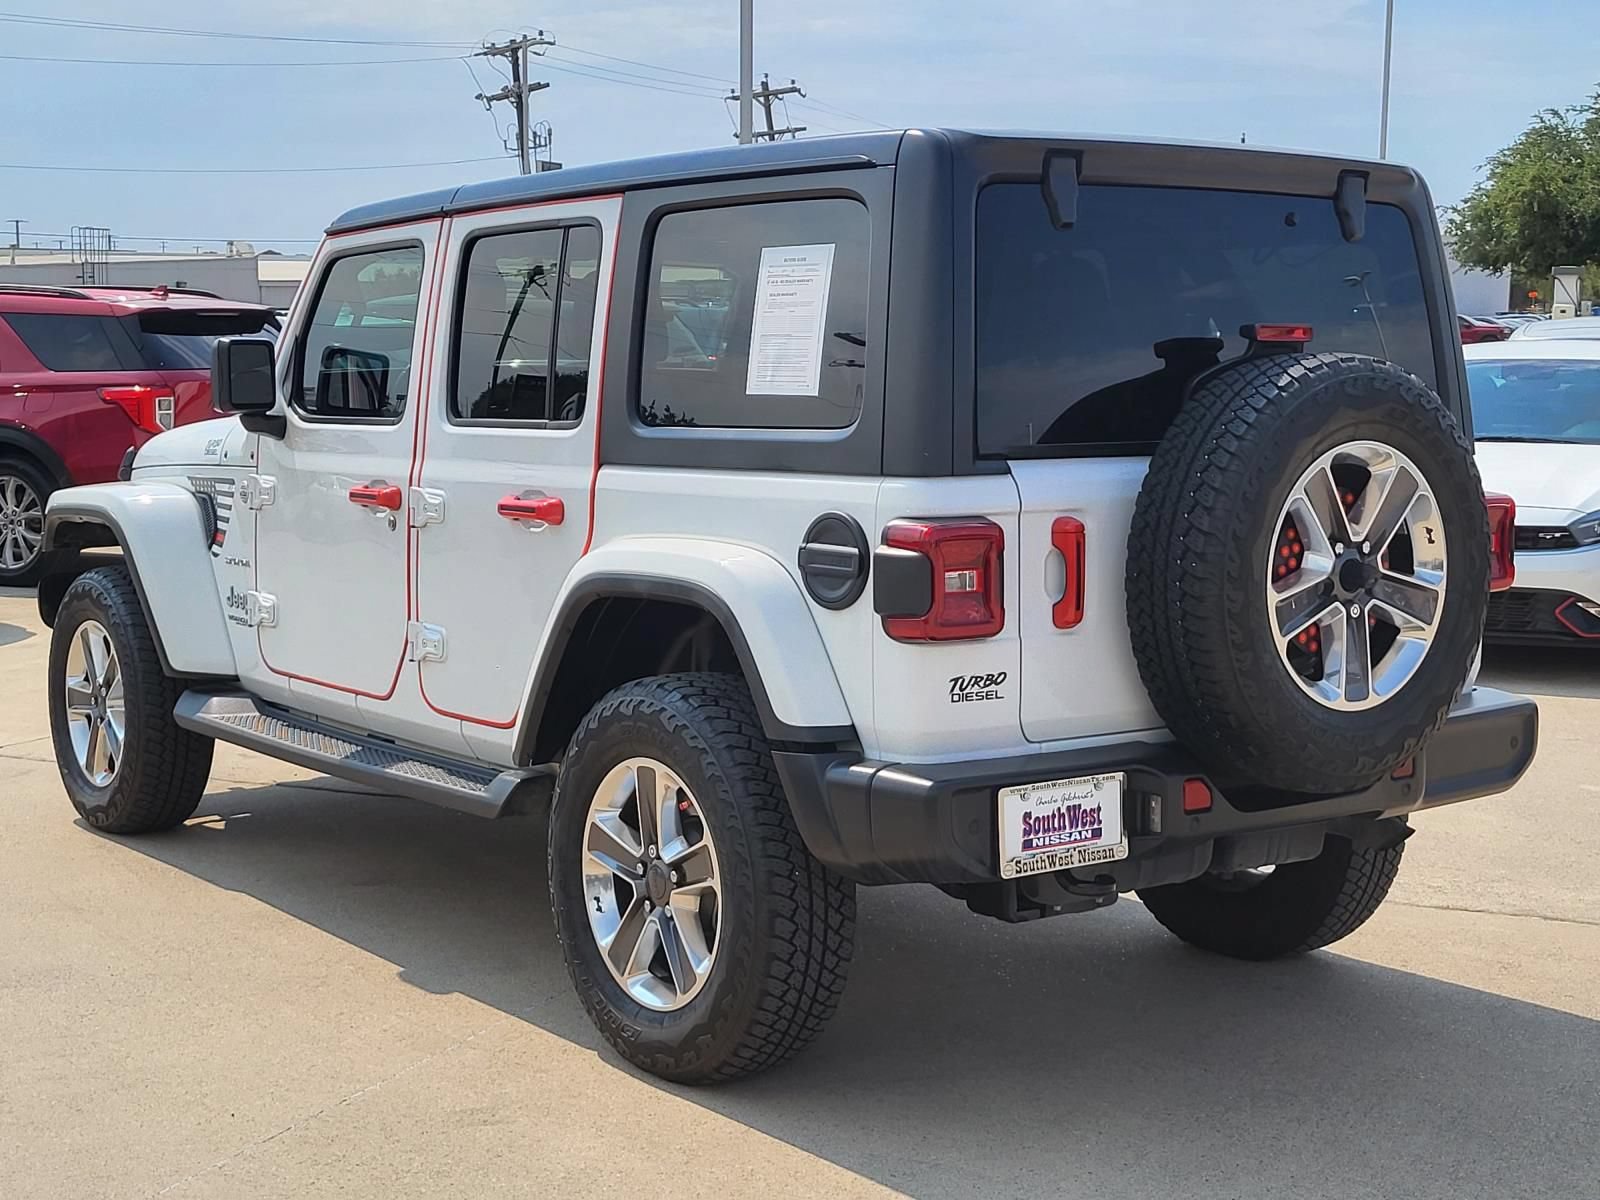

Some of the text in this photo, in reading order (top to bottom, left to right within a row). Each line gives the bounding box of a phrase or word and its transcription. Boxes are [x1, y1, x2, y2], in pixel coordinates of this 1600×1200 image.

[949, 671, 1007, 695] TURBO
[951, 689, 1005, 703] DIESEL
[1022, 801, 1103, 838] SouthWest
[1032, 829, 1092, 848] NISSAN
[1014, 851, 1075, 875] SouthWest
[1077, 847, 1116, 864] Nissan
